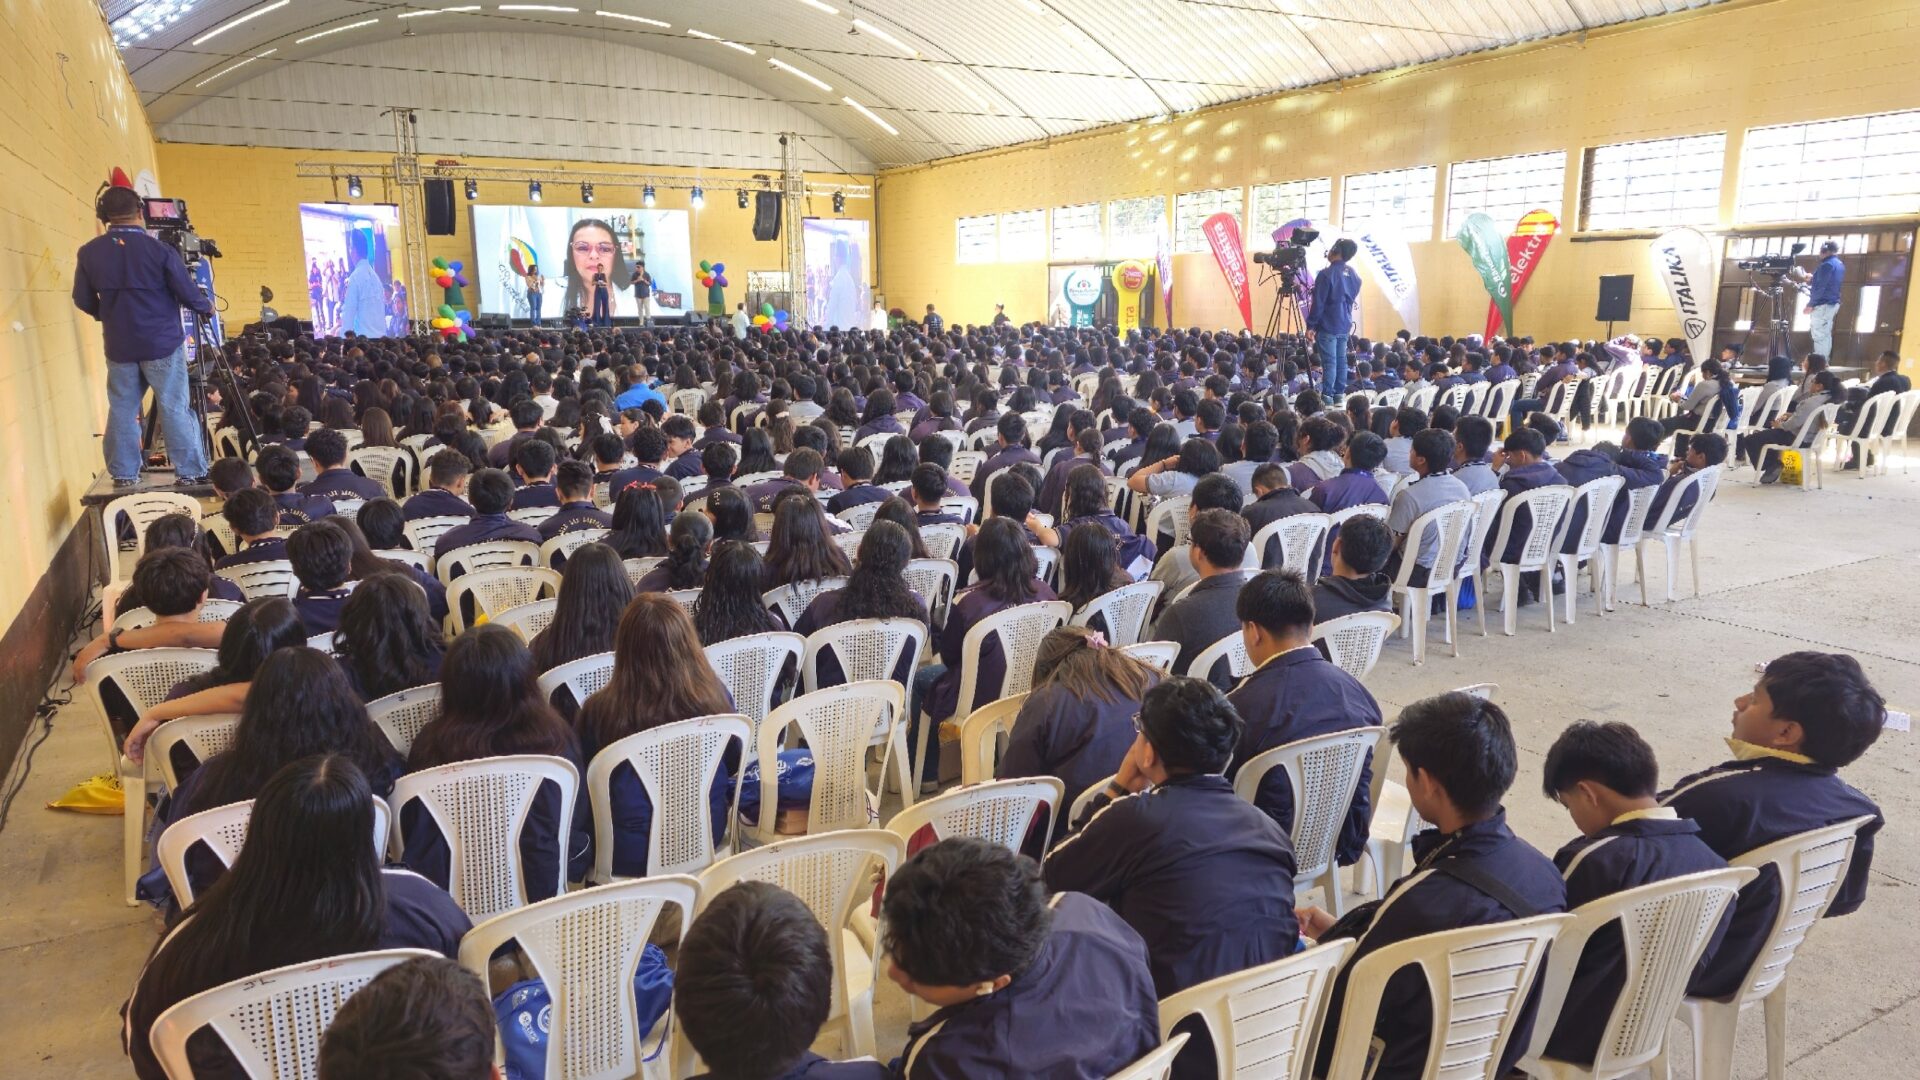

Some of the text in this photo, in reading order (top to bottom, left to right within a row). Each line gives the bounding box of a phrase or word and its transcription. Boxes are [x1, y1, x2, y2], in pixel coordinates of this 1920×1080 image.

[1360, 233, 1398, 282] ITALIKA
[1510, 231, 1544, 284] elektr
[1662, 246, 1699, 315] ITALIKA
